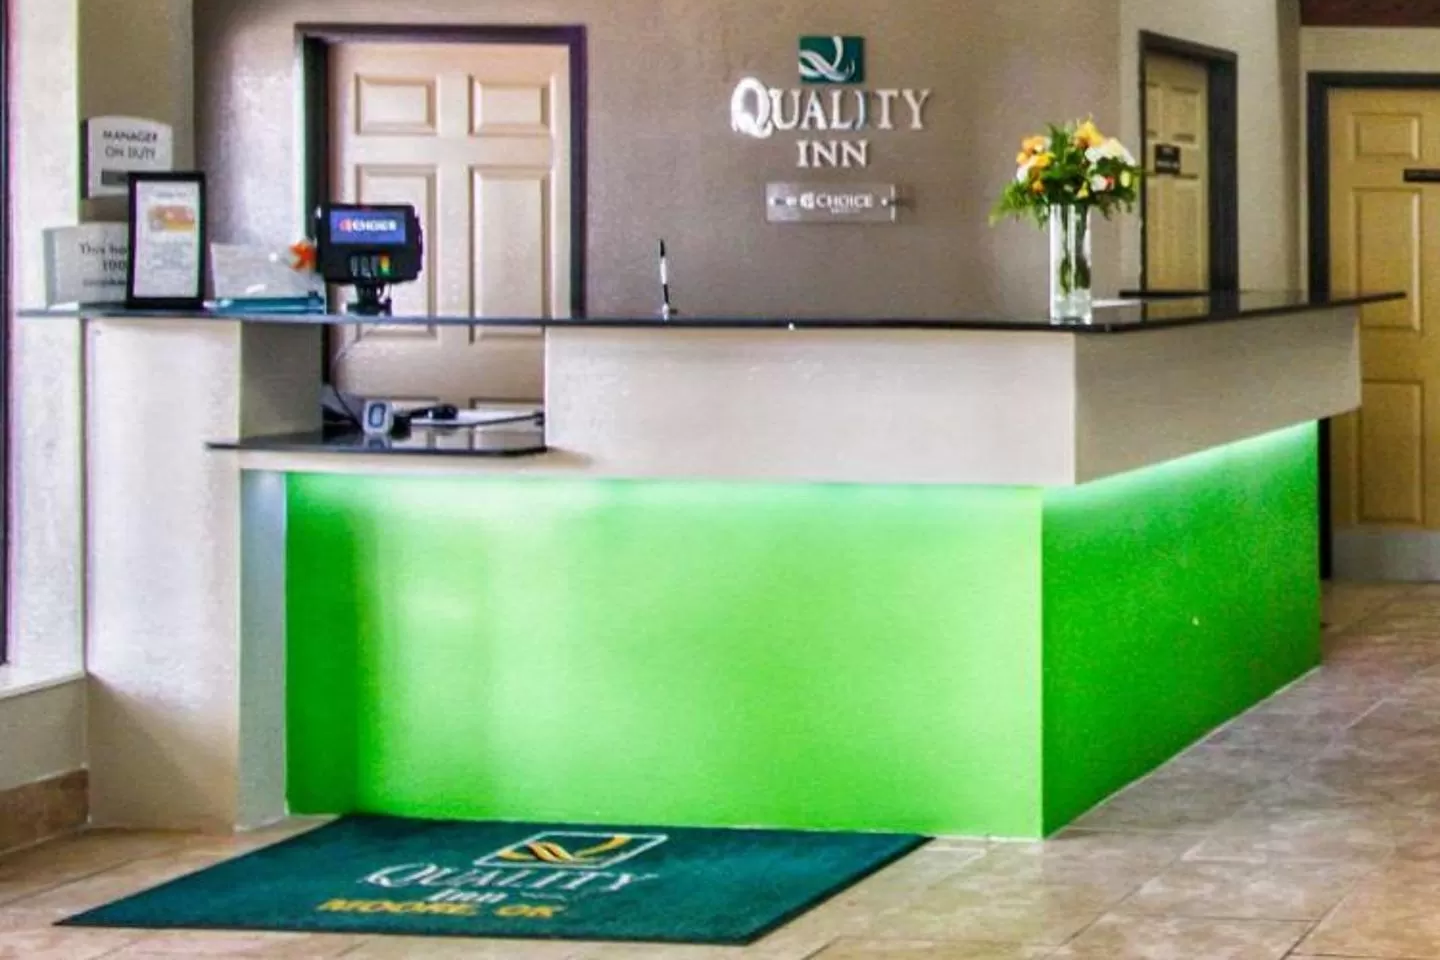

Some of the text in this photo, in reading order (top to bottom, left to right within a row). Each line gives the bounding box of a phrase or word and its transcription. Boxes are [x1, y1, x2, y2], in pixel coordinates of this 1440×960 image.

[731, 77, 931, 138] QUALITY
[103, 129, 158, 143] MANAGER
[105, 146, 156, 159] ON DUTY
[796, 140, 869, 167] INN
[816, 192, 873, 208] CHOICE
[357, 863, 660, 891] QUALITY
